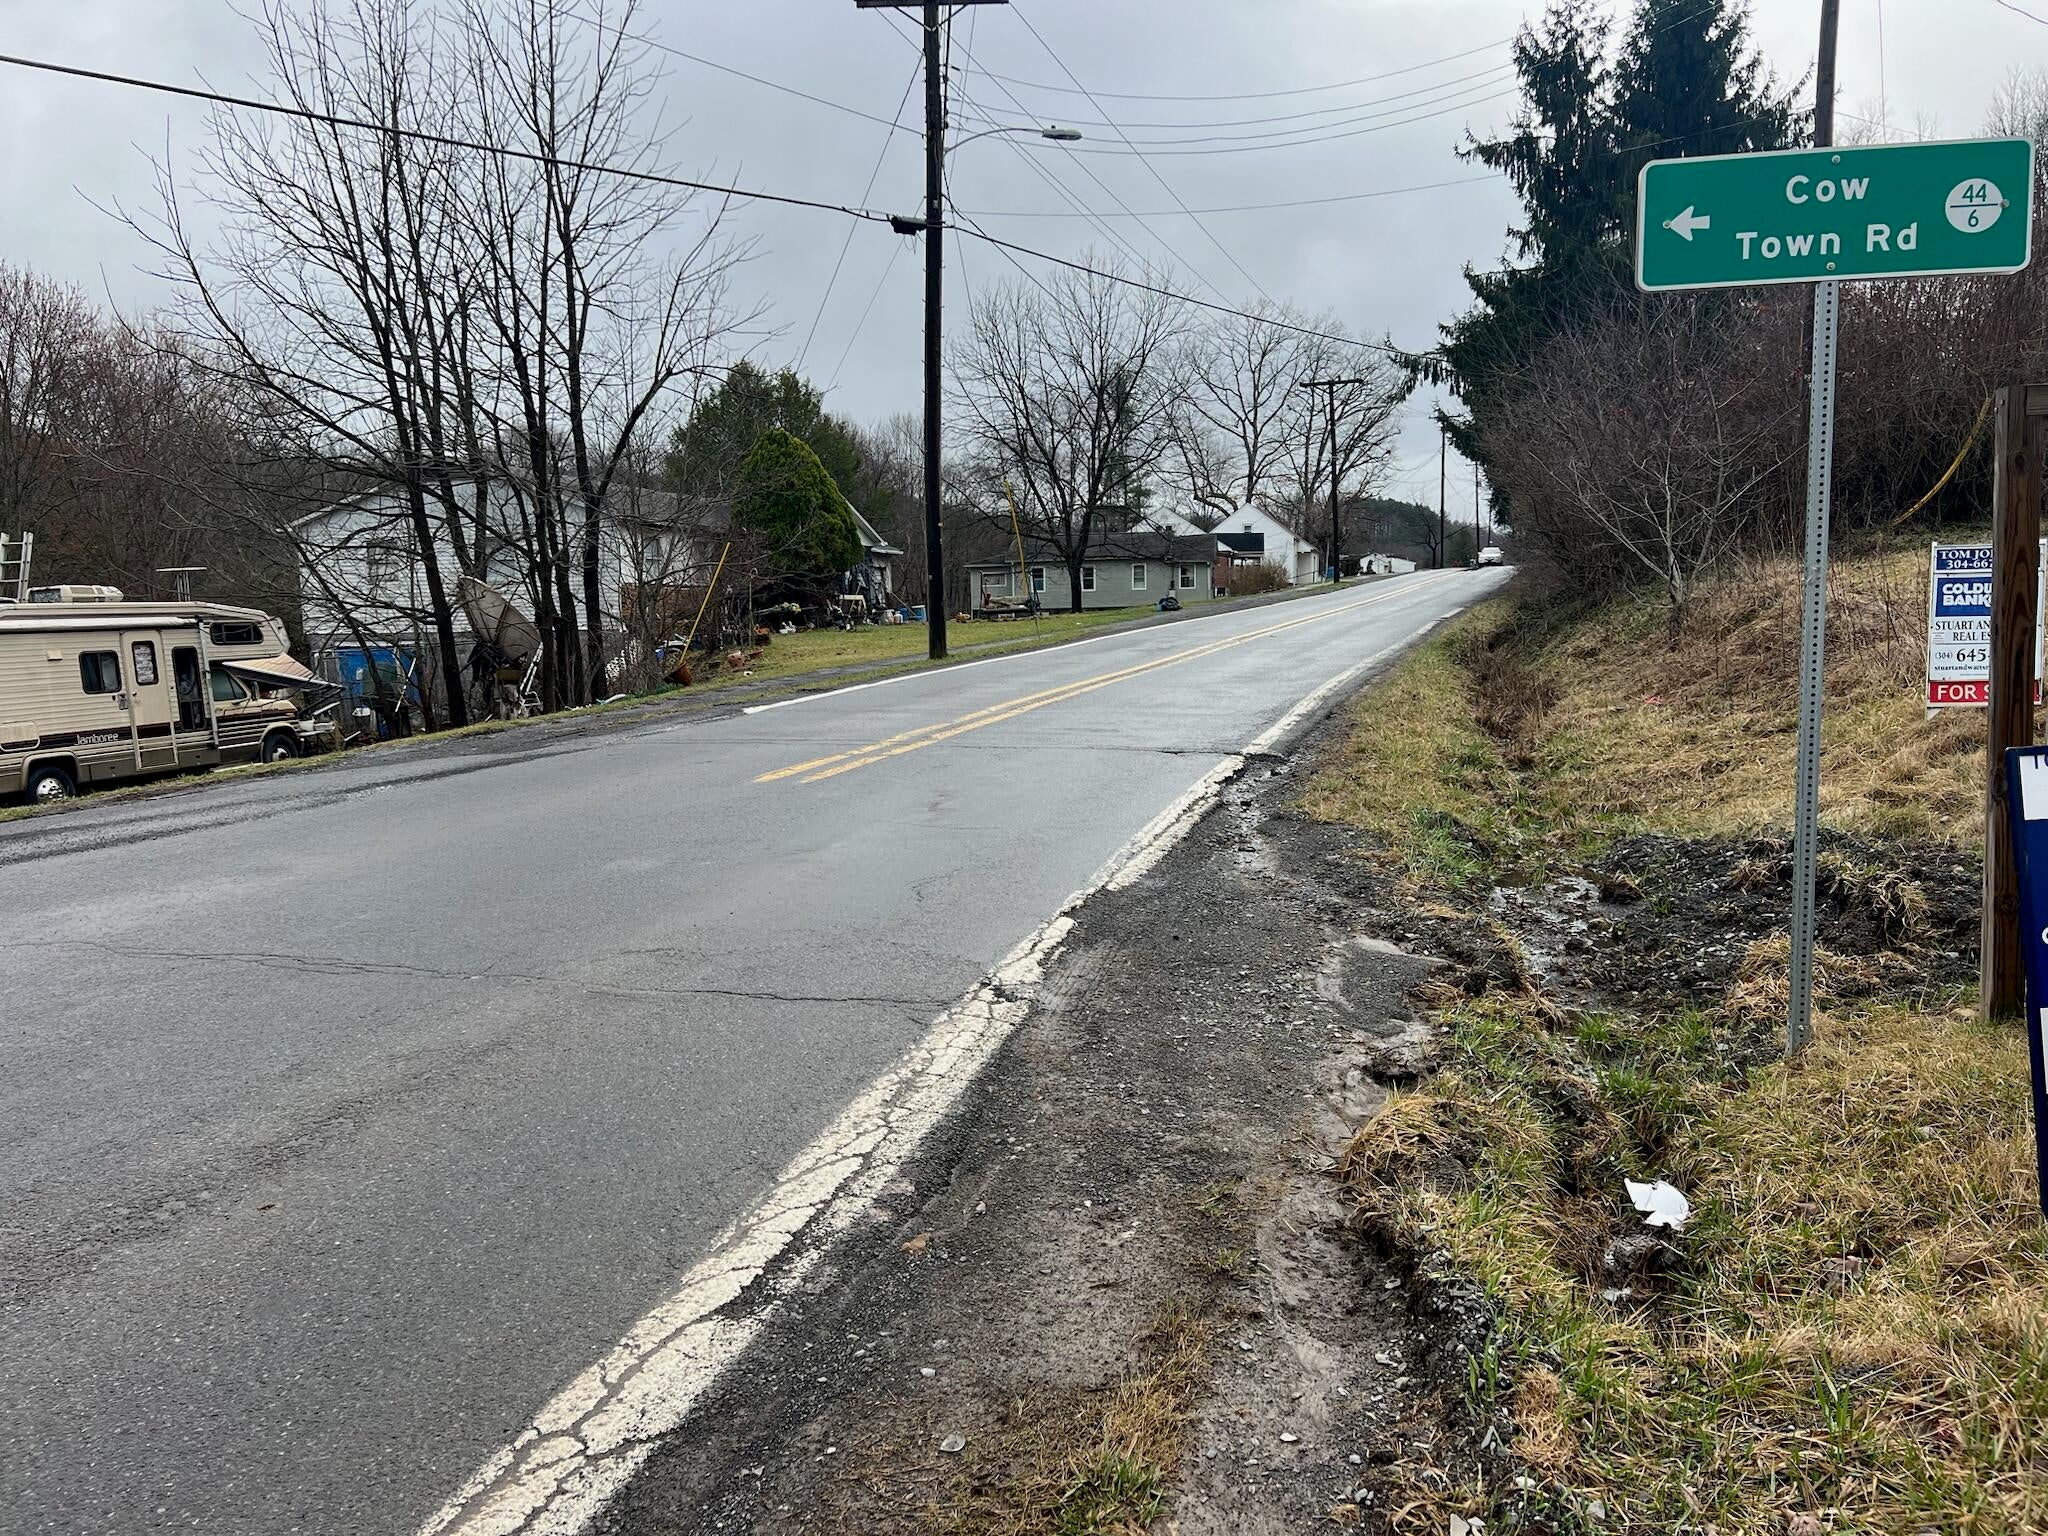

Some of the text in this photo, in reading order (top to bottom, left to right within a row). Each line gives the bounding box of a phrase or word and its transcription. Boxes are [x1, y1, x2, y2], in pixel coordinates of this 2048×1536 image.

[1786, 175, 1870, 204] Cow
[1962, 183, 1987, 203] 44
[1968, 209, 1979, 228] 6
[1735, 222, 1918, 260] Town Rd
[1940, 549, 1993, 560] TOM JO
[1943, 594, 1992, 607] BANK
[1935, 620, 1974, 630] STUART
[1953, 632, 1978, 641] REAL
[1935, 651, 1953, 660] (304)
[1937, 684, 1978, 700] FOR
[74, 733, 119, 746] Jamboree
